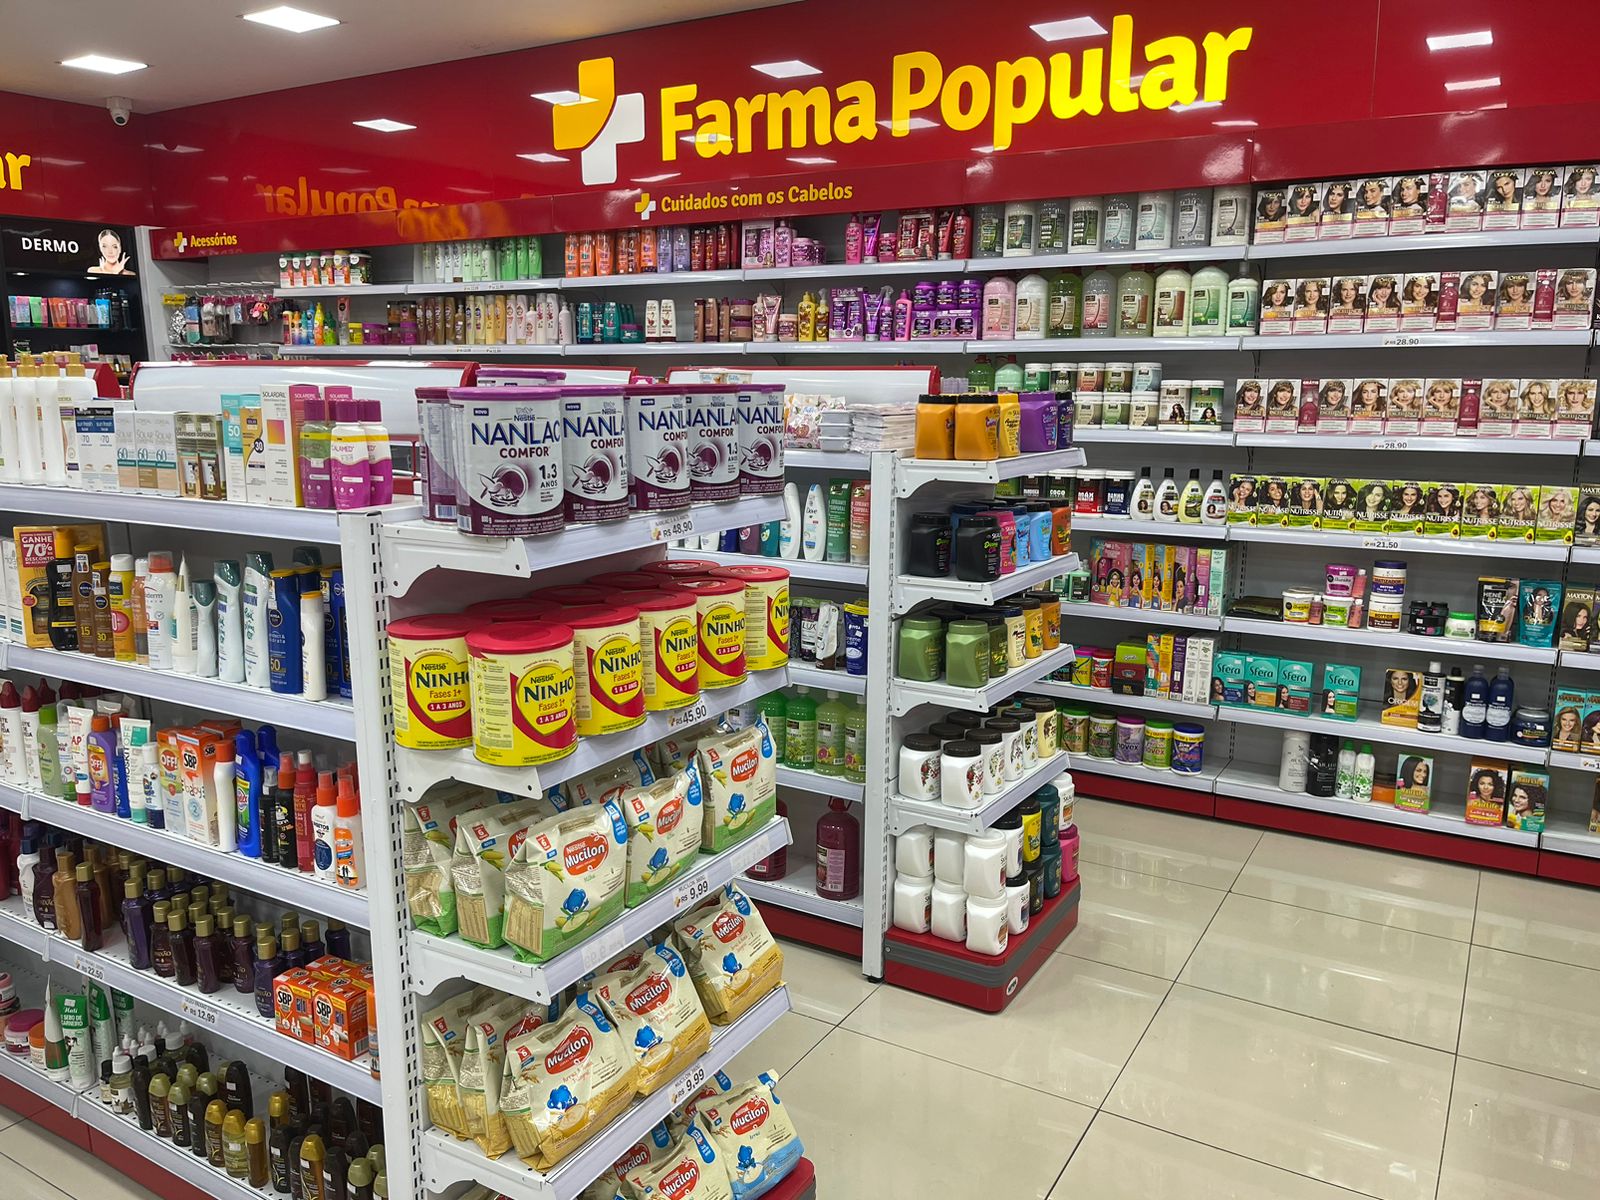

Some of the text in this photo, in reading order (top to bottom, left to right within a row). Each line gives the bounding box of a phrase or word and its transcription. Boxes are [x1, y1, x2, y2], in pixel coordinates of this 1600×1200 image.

[660, 14, 1253, 161] Farma Popular
[661, 182, 853, 213] Cuidados com os Cabelos
[21, 237, 80, 254] DERMO
[190, 233, 238, 248] Acessórios
[514, 414, 535, 422] Nestlé
[228, 425, 240, 437] 50
[471, 421, 561, 446] NANLAC
[254, 440, 263, 450] 30
[117, 448, 128, 460] 60
[138, 448, 149, 460] 60
[156, 449, 167, 461] 60
[500, 447, 550, 459] COMFOR
[663, 521, 693, 538] R$ 48,90
[21, 535, 53, 544] GANHE
[22, 543, 53, 558] 70%
[1566, 592, 1594, 600] MAXTON
[81, 626, 91, 636] 15
[802, 621, 817, 630] LUX
[97, 632, 107, 641] 30
[718, 636, 733, 645] Fases
[605, 646, 627, 656] Nestlé
[676, 652, 690, 661] Fases
[421, 663, 447, 671] Nestlé
[1216, 663, 1241, 675] Sfera
[1250, 666, 1274, 678] Sfera
[531, 674, 555, 684] Nestlé
[613, 671, 630, 682] Fases
[1282, 670, 1307, 683] Sfera
[1328, 674, 1355, 687] Sfera
[429, 689, 452, 699] Fases
[524, 677, 574, 703] NINHO
[436, 702, 442, 711] A
[448, 701, 463, 709] ANOS
[538, 701, 557, 712] Fases
[544, 715, 550, 723] A
[555, 711, 568, 721] ANOS
[683, 705, 707, 722] 45,90
[161, 755, 178, 769] OFF!
[184, 752, 197, 769] SBP
[565, 844, 606, 869] Mucilon
[681, 881, 708, 903] R$ 9,99
[278, 991, 292, 1006] SBP
[629, 981, 668, 1011] Mucilon
[316, 1001, 331, 1018] SBP
[197, 1011, 216, 1024] 12,99
[547, 1036, 588, 1068] Mucilon
[678, 1068, 705, 1098] R$ 9,99
[732, 1105, 767, 1130] Mucilon
[617, 1150, 648, 1176] Mucilon
[662, 1167, 697, 1197] Mucilon
